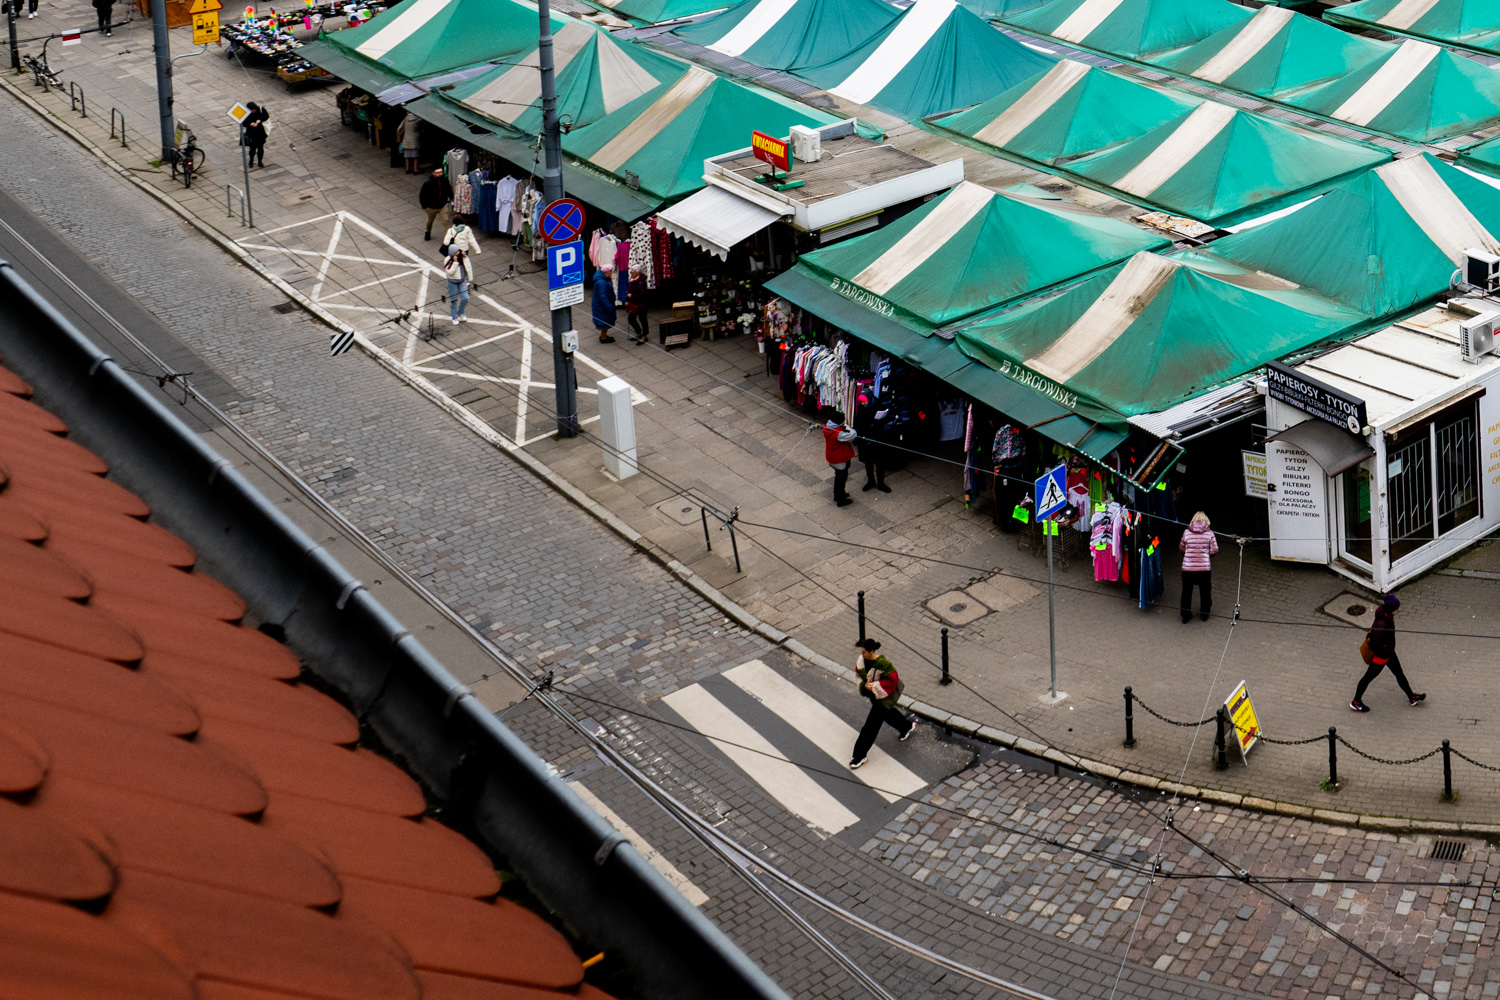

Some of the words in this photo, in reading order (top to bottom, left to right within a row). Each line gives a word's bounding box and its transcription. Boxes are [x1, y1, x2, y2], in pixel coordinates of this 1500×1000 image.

[752, 133, 785, 158] KWIACIARNIA
[556, 247, 576, 276] P
[839, 281, 894, 317] TARGOWISKA
[1012, 365, 1078, 409] TARGOWISKA
[1268, 368, 1319, 400] PAPIEROSY
[1324, 393, 1359, 418] TYTOŃ
[1284, 489, 1310, 497] BONGO
